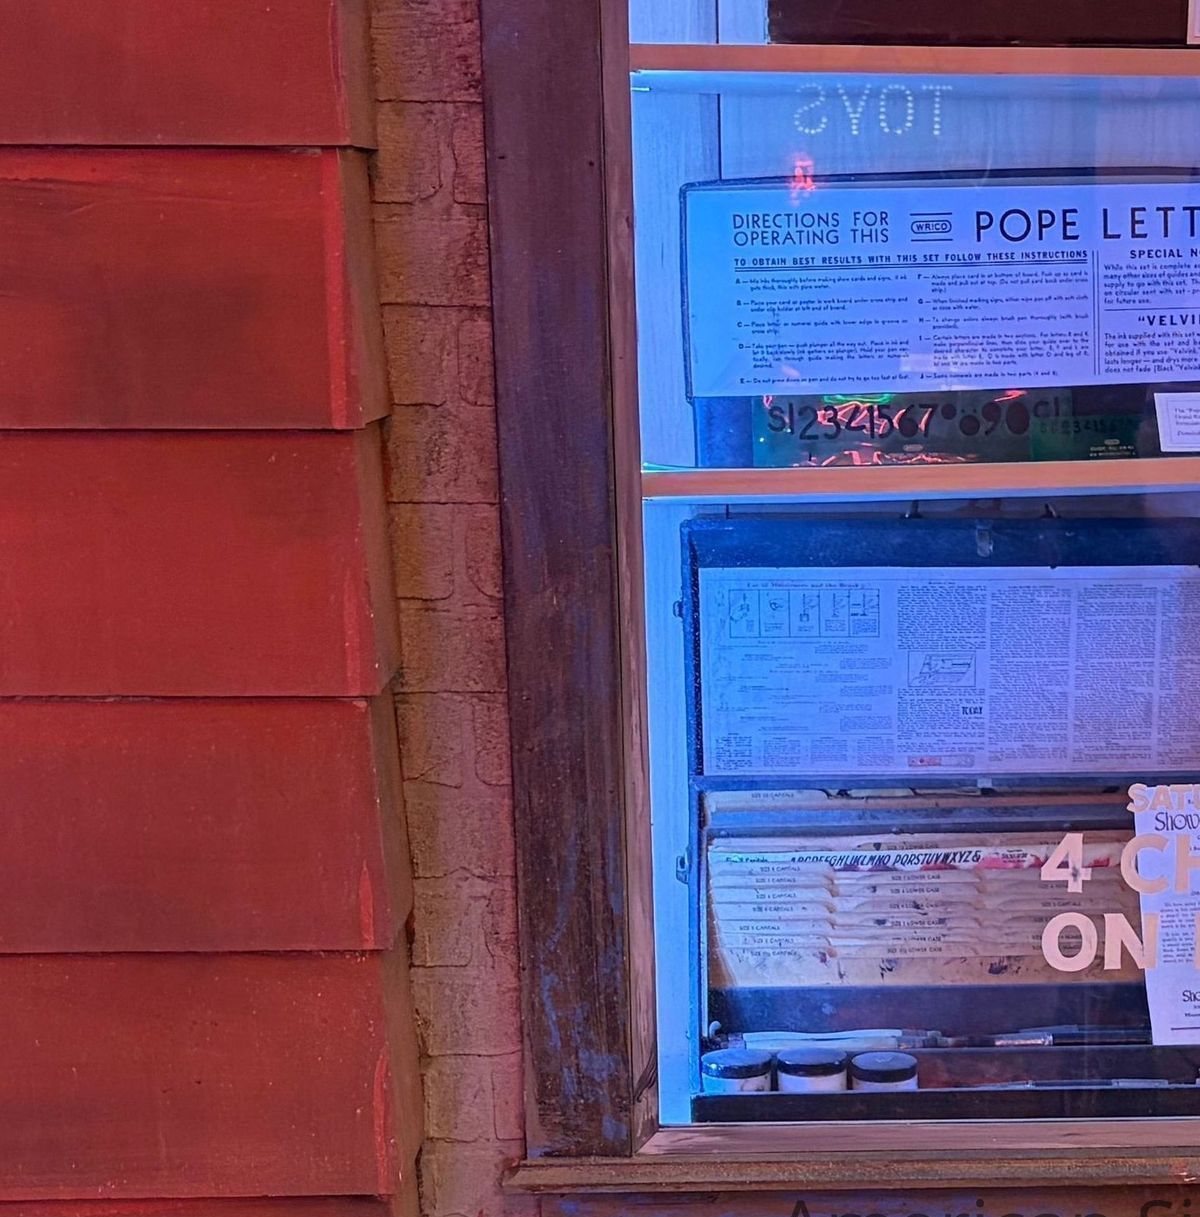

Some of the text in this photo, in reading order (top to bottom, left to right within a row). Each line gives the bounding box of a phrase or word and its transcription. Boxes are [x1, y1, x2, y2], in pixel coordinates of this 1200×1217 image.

[732, 211, 889, 229] DIRECTIONS FOR
[916, 223, 948, 231] WRICO
[976, 208, 1079, 242] POPE
[734, 228, 889, 246] OPERATING THIS
[734, 250, 1088, 266] TO OBTAIN BEST RESULTS WITH THIS SET FOLLOW THESE INSTRUCTIONS
[1130, 249, 1183, 259] SPECIAL
[1040, 833, 1092, 893] 4
[1041, 911, 1158, 973] ON
